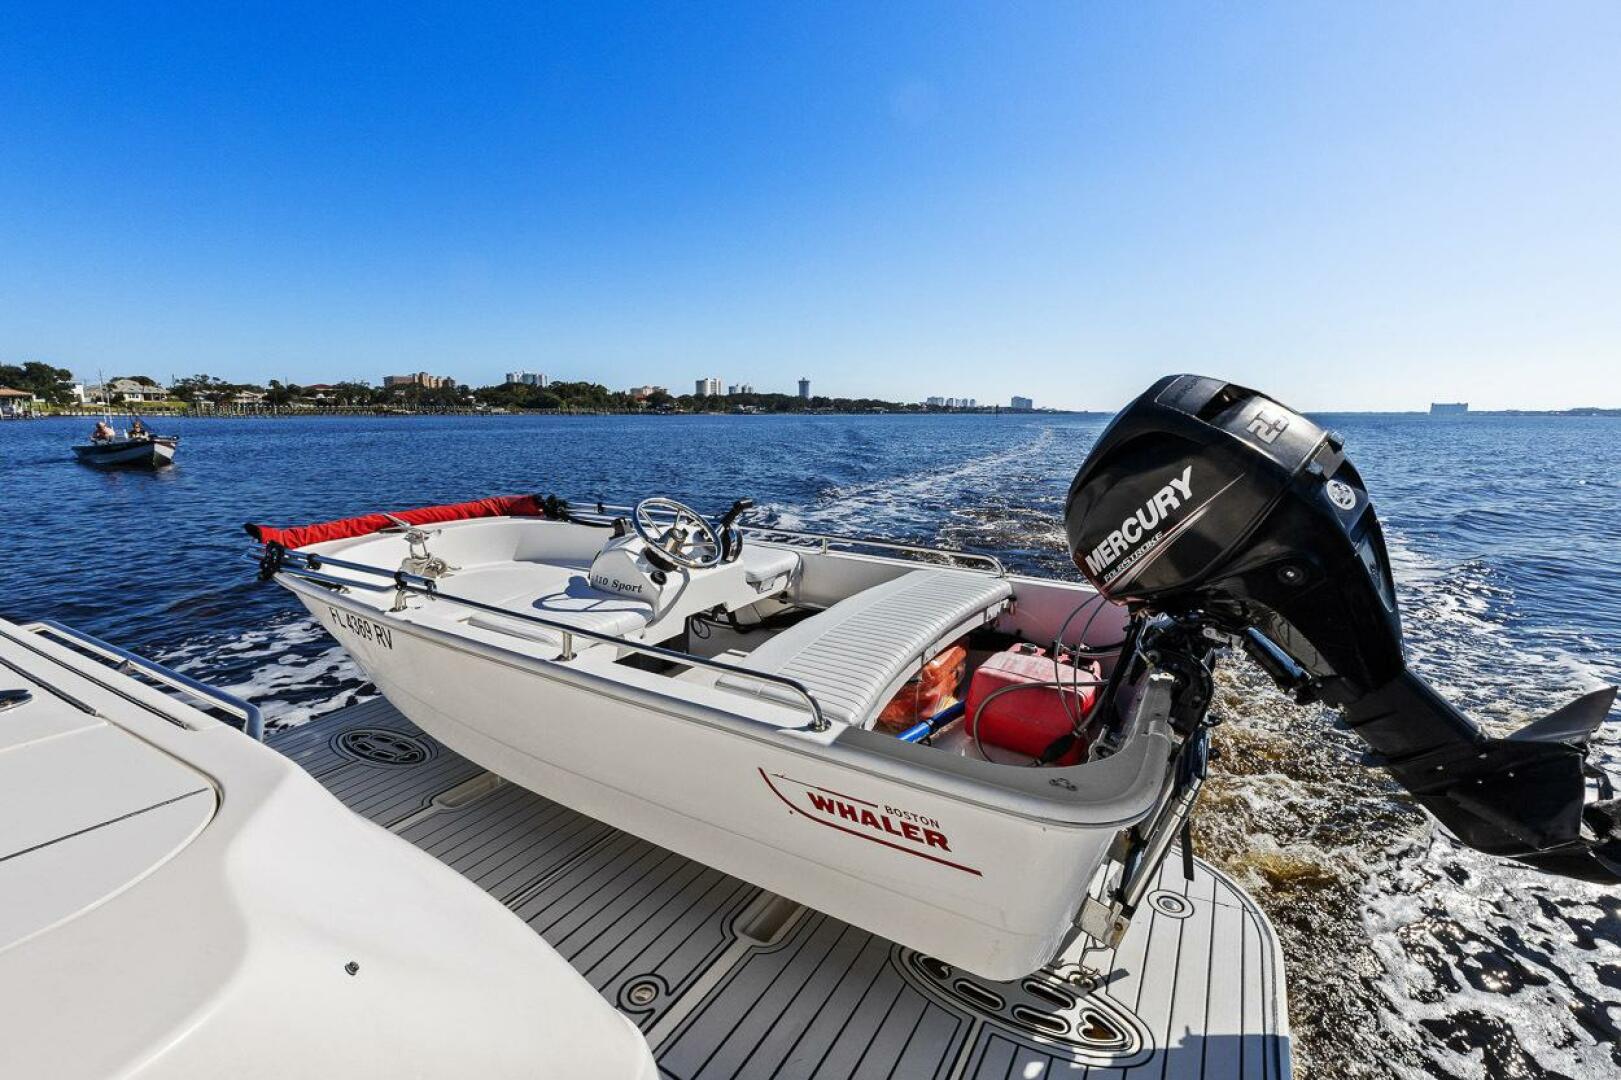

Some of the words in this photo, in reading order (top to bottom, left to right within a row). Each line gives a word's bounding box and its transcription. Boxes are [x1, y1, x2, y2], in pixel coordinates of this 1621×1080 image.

[1084, 464, 1193, 577] MERCURY
[611, 578, 643, 593] Sport
[328, 606, 347, 629] FL
[373, 623, 393, 650] RV
[806, 791, 953, 853] WHALER
[884, 804, 941, 830] BOSTON
